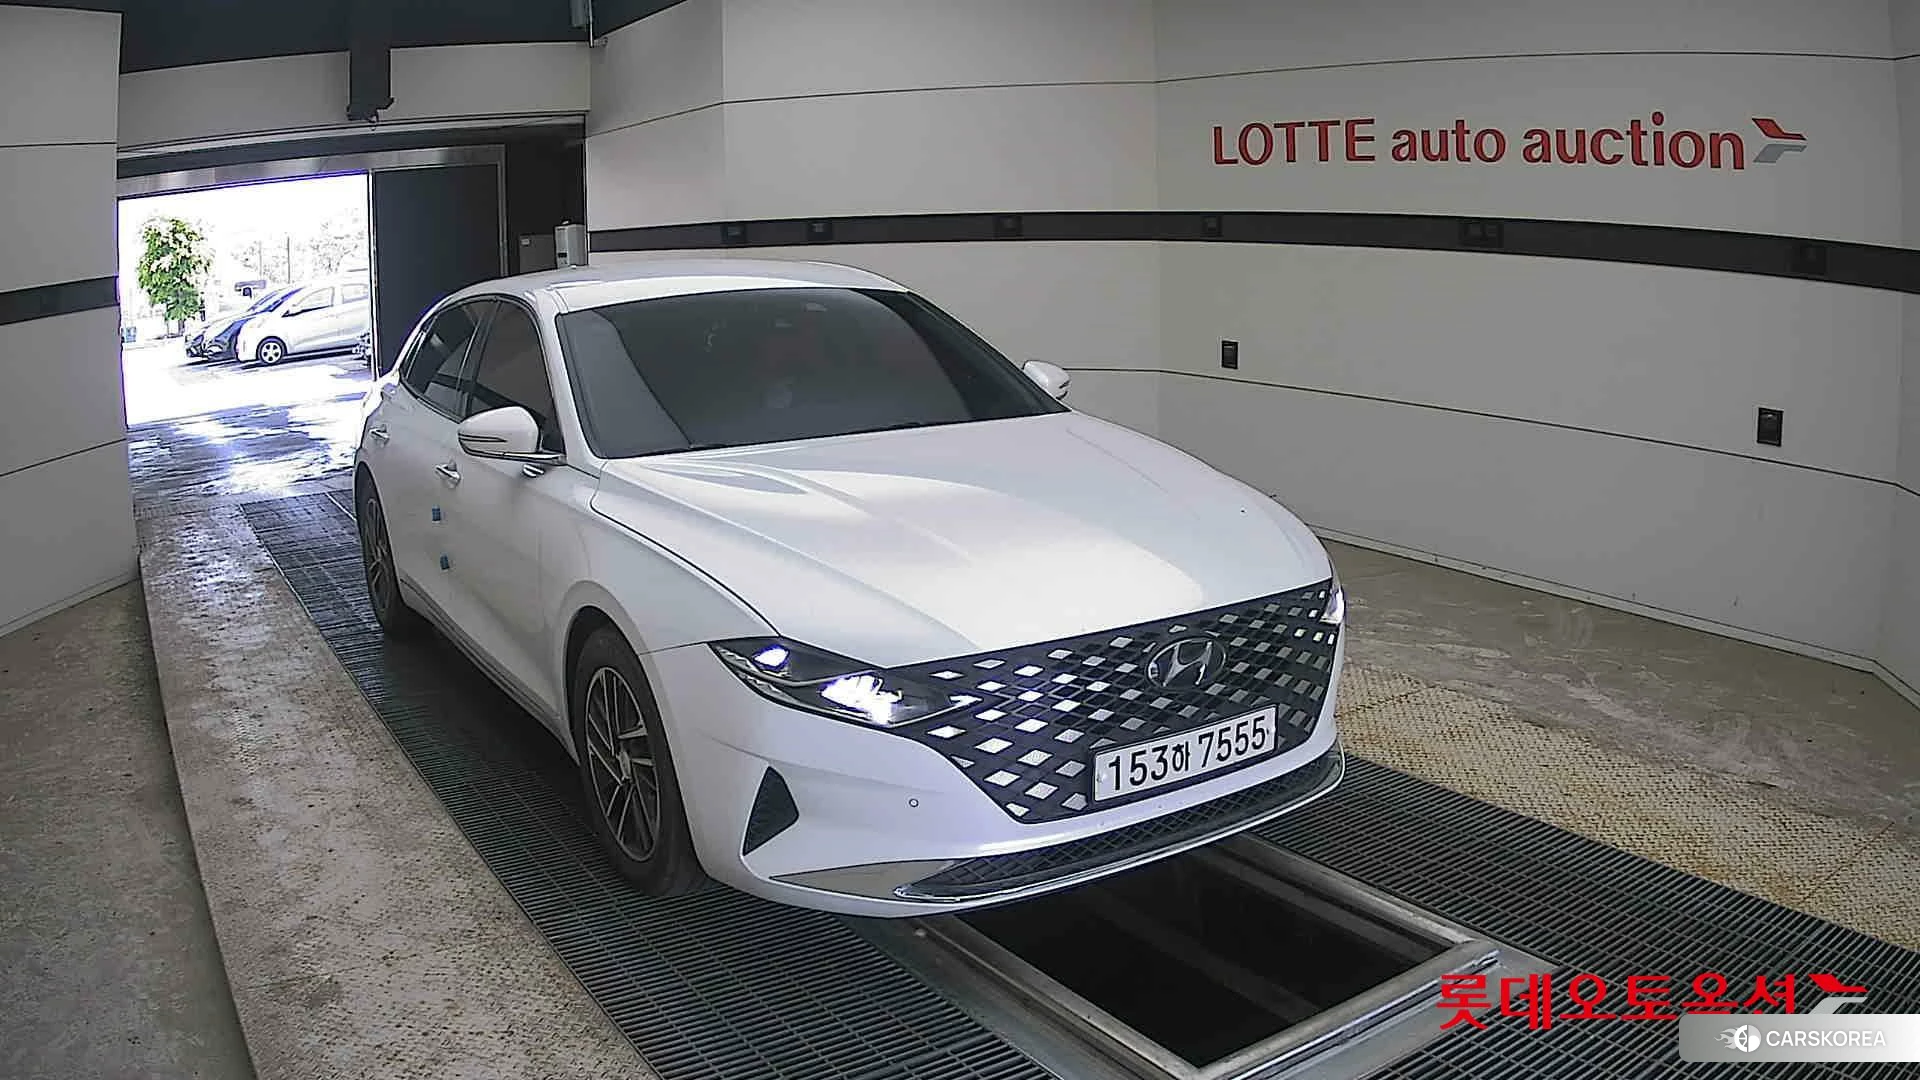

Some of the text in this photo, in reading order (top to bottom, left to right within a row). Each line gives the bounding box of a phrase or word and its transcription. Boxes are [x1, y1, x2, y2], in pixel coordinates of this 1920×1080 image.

[1213, 111, 1746, 170] LOTTE auto auction
[1108, 715, 1267, 791] 153하 7555
